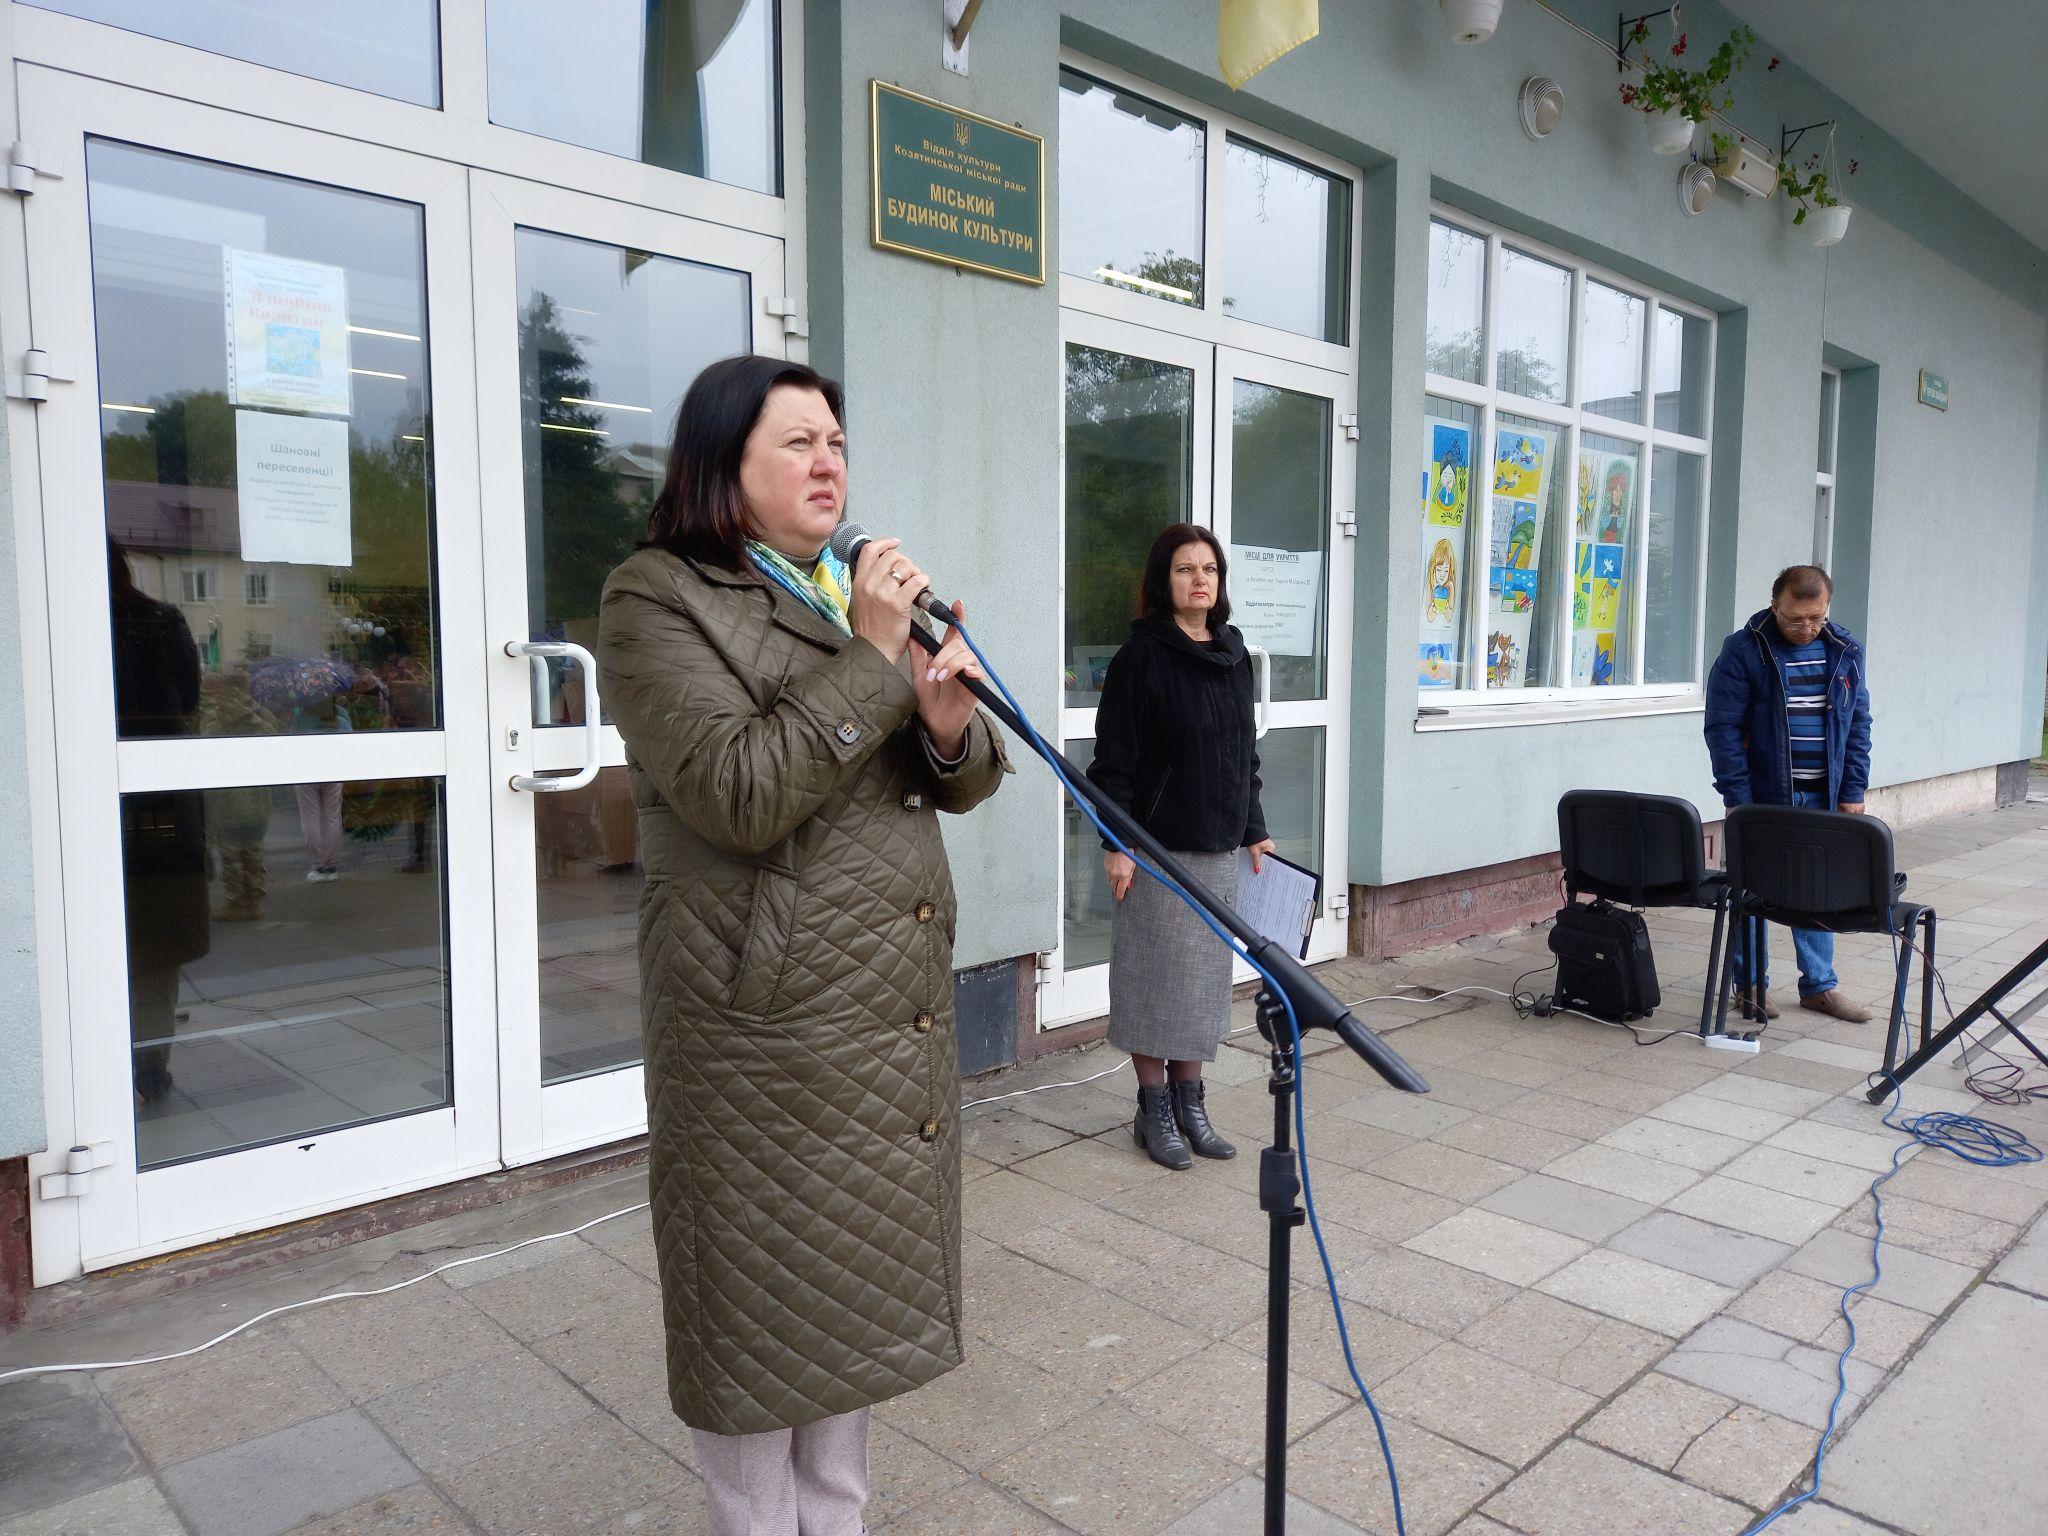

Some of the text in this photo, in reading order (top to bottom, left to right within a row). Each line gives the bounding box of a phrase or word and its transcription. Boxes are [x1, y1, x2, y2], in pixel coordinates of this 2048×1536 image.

[894, 145, 1027, 193] Козятинської міської ради
[922, 140, 1001, 173] Відділ культури
[930, 183, 996, 219] МІСЬКИЙ
[887, 197, 1033, 254] БУДИНОК КУЛЬТУРИ
[270, 443, 321, 458] Шановні
[257, 461, 333, 478] переселенці!
